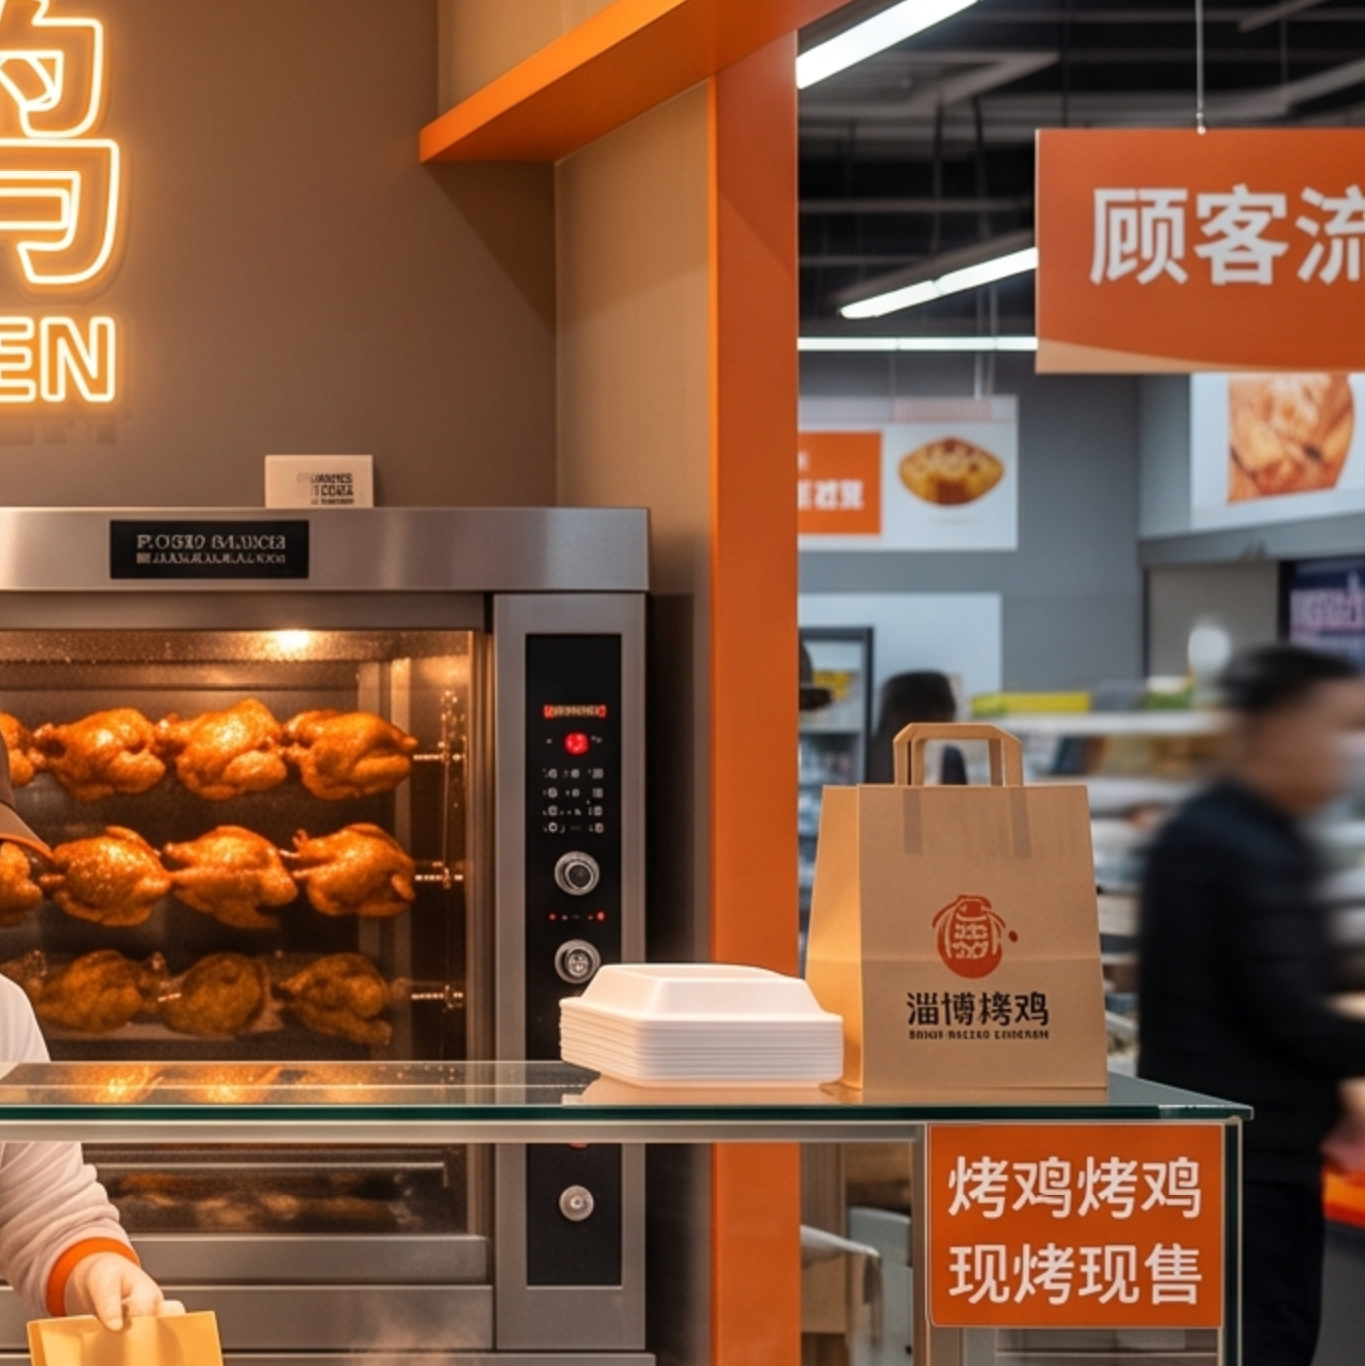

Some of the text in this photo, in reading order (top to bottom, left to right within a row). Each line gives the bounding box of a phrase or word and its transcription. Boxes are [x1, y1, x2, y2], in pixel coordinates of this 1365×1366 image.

[948, 1155, 1203, 1219] 烤鸡烤鸡
[948, 1242, 1203, 1306] 现烤现售
